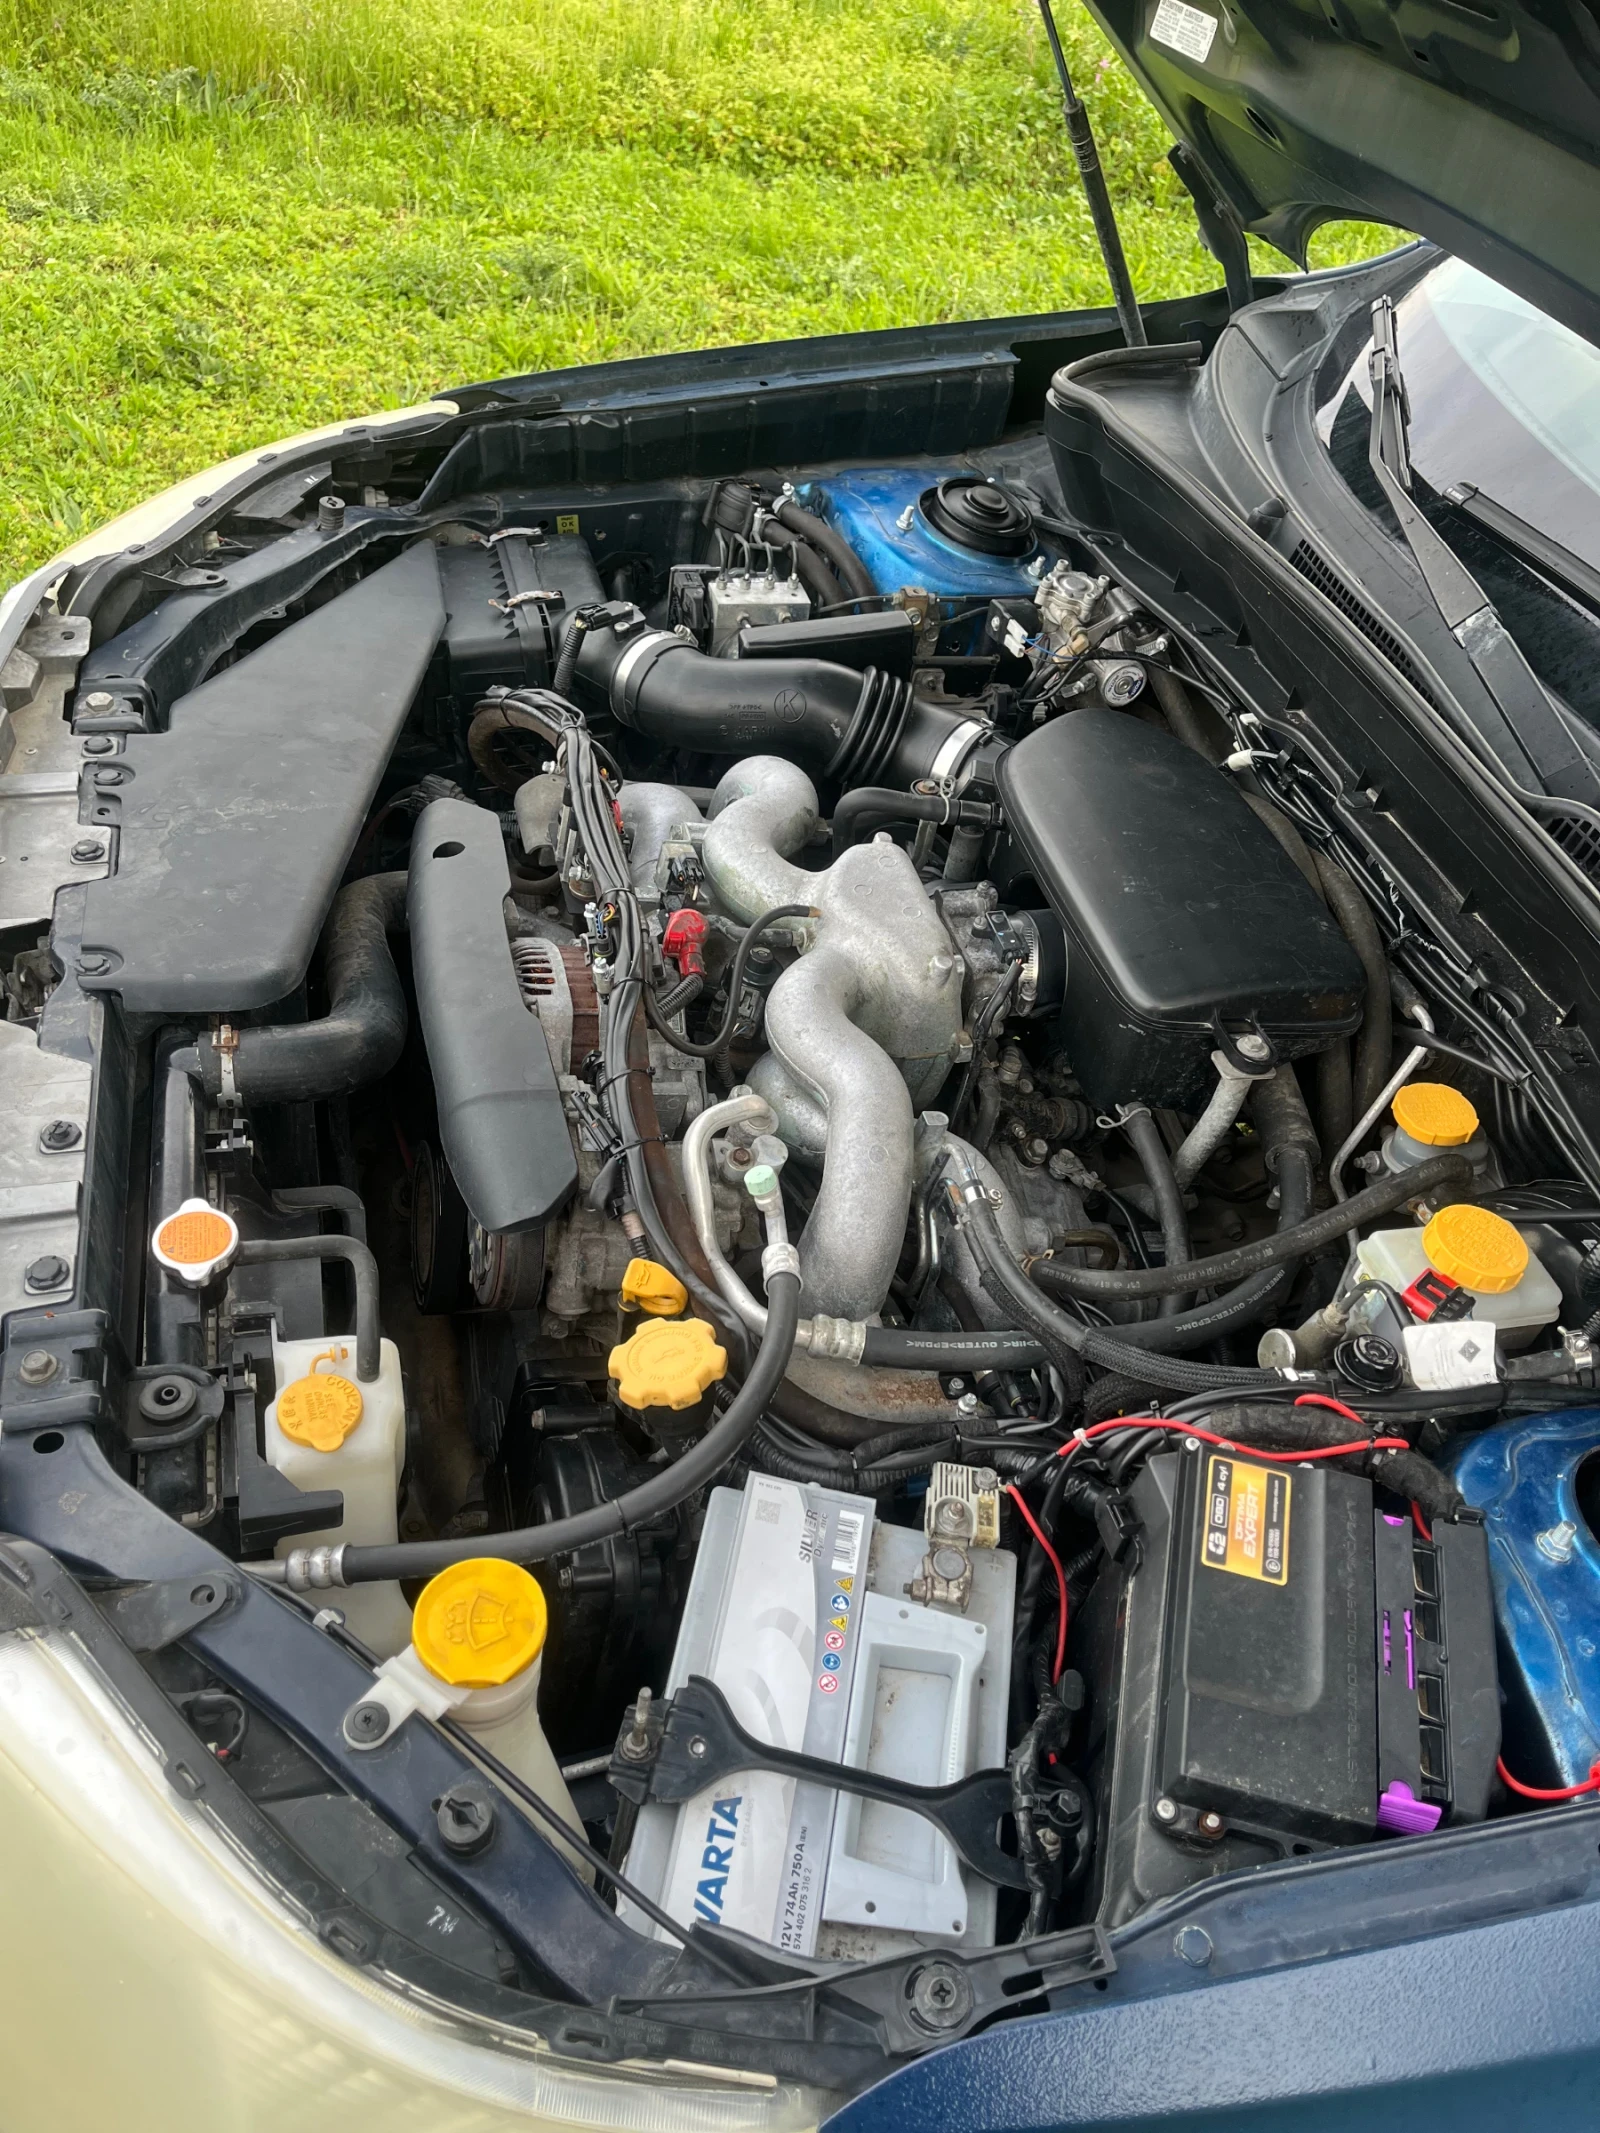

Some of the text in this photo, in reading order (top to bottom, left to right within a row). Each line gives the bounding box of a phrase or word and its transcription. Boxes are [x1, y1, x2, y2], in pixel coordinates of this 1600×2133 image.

[326, 1376, 359, 1430] COOLANT
[1217, 1481, 1227, 1491] 4
[1219, 1465, 1229, 1482] cyl
[1214, 1497, 1225, 1524] OBD
[1235, 1493, 1246, 1540] OPTIMA
[1243, 1482, 1259, 1559] EXPERT
[798, 1508, 819, 1563] SILVER
[693, 1796, 743, 1924] VARTA
[798, 1893, 808, 1912] 075
[796, 1912, 806, 1931] 402
[793, 1932, 803, 1950] 574
